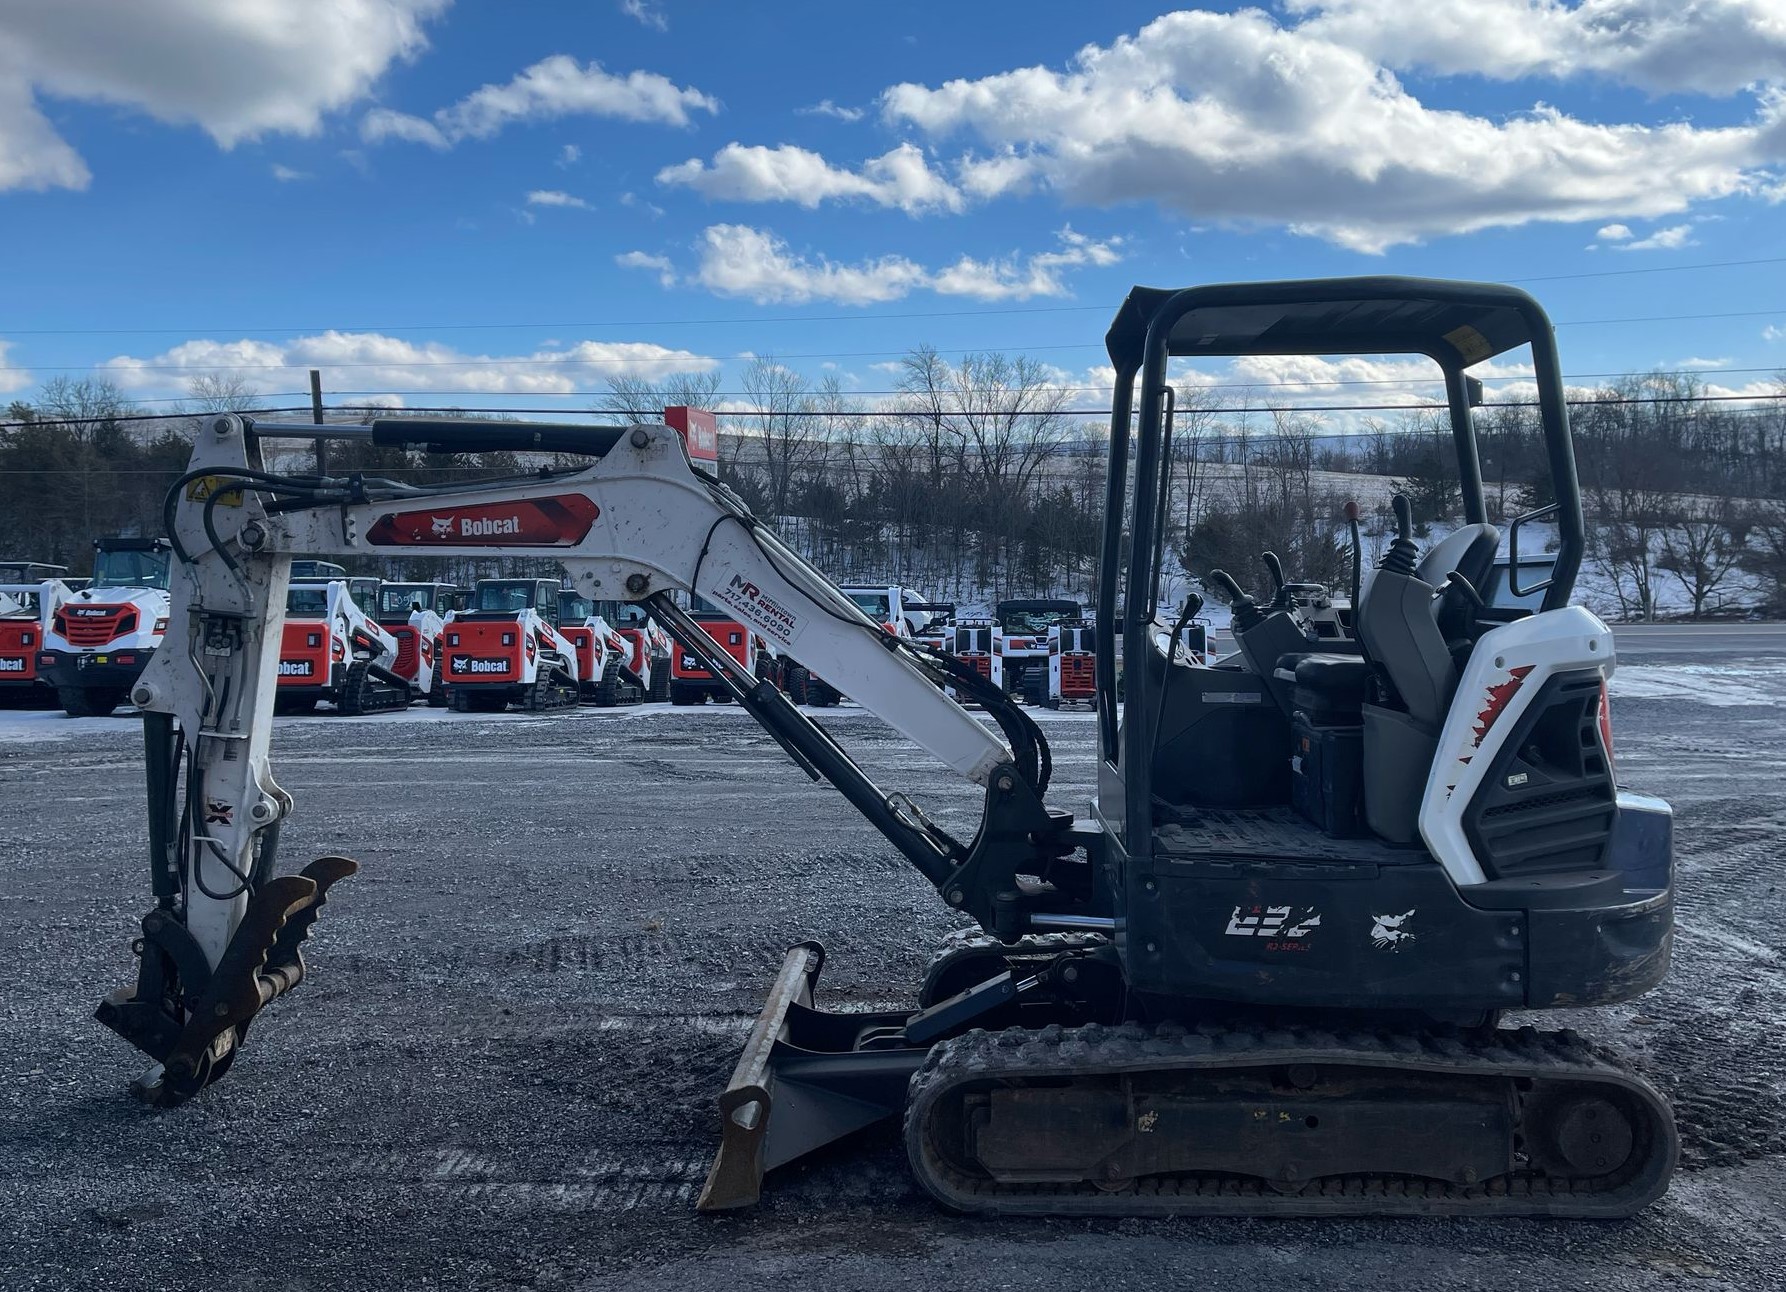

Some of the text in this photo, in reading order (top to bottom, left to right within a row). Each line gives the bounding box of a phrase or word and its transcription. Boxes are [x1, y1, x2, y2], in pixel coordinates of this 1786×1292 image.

[461, 516, 520, 536] Bobcat
[730, 574, 760, 602] MR
[712, 590, 792, 646] parts, sales, and service
[724, 588, 791, 636] 717.436.6090
[757, 600, 795, 629] RENTAL
[761, 594, 797, 621] Mifflintown
[0, 658, 23, 671] bcat
[278, 661, 309, 675] obcat
[471, 659, 508, 673] Bobcat
